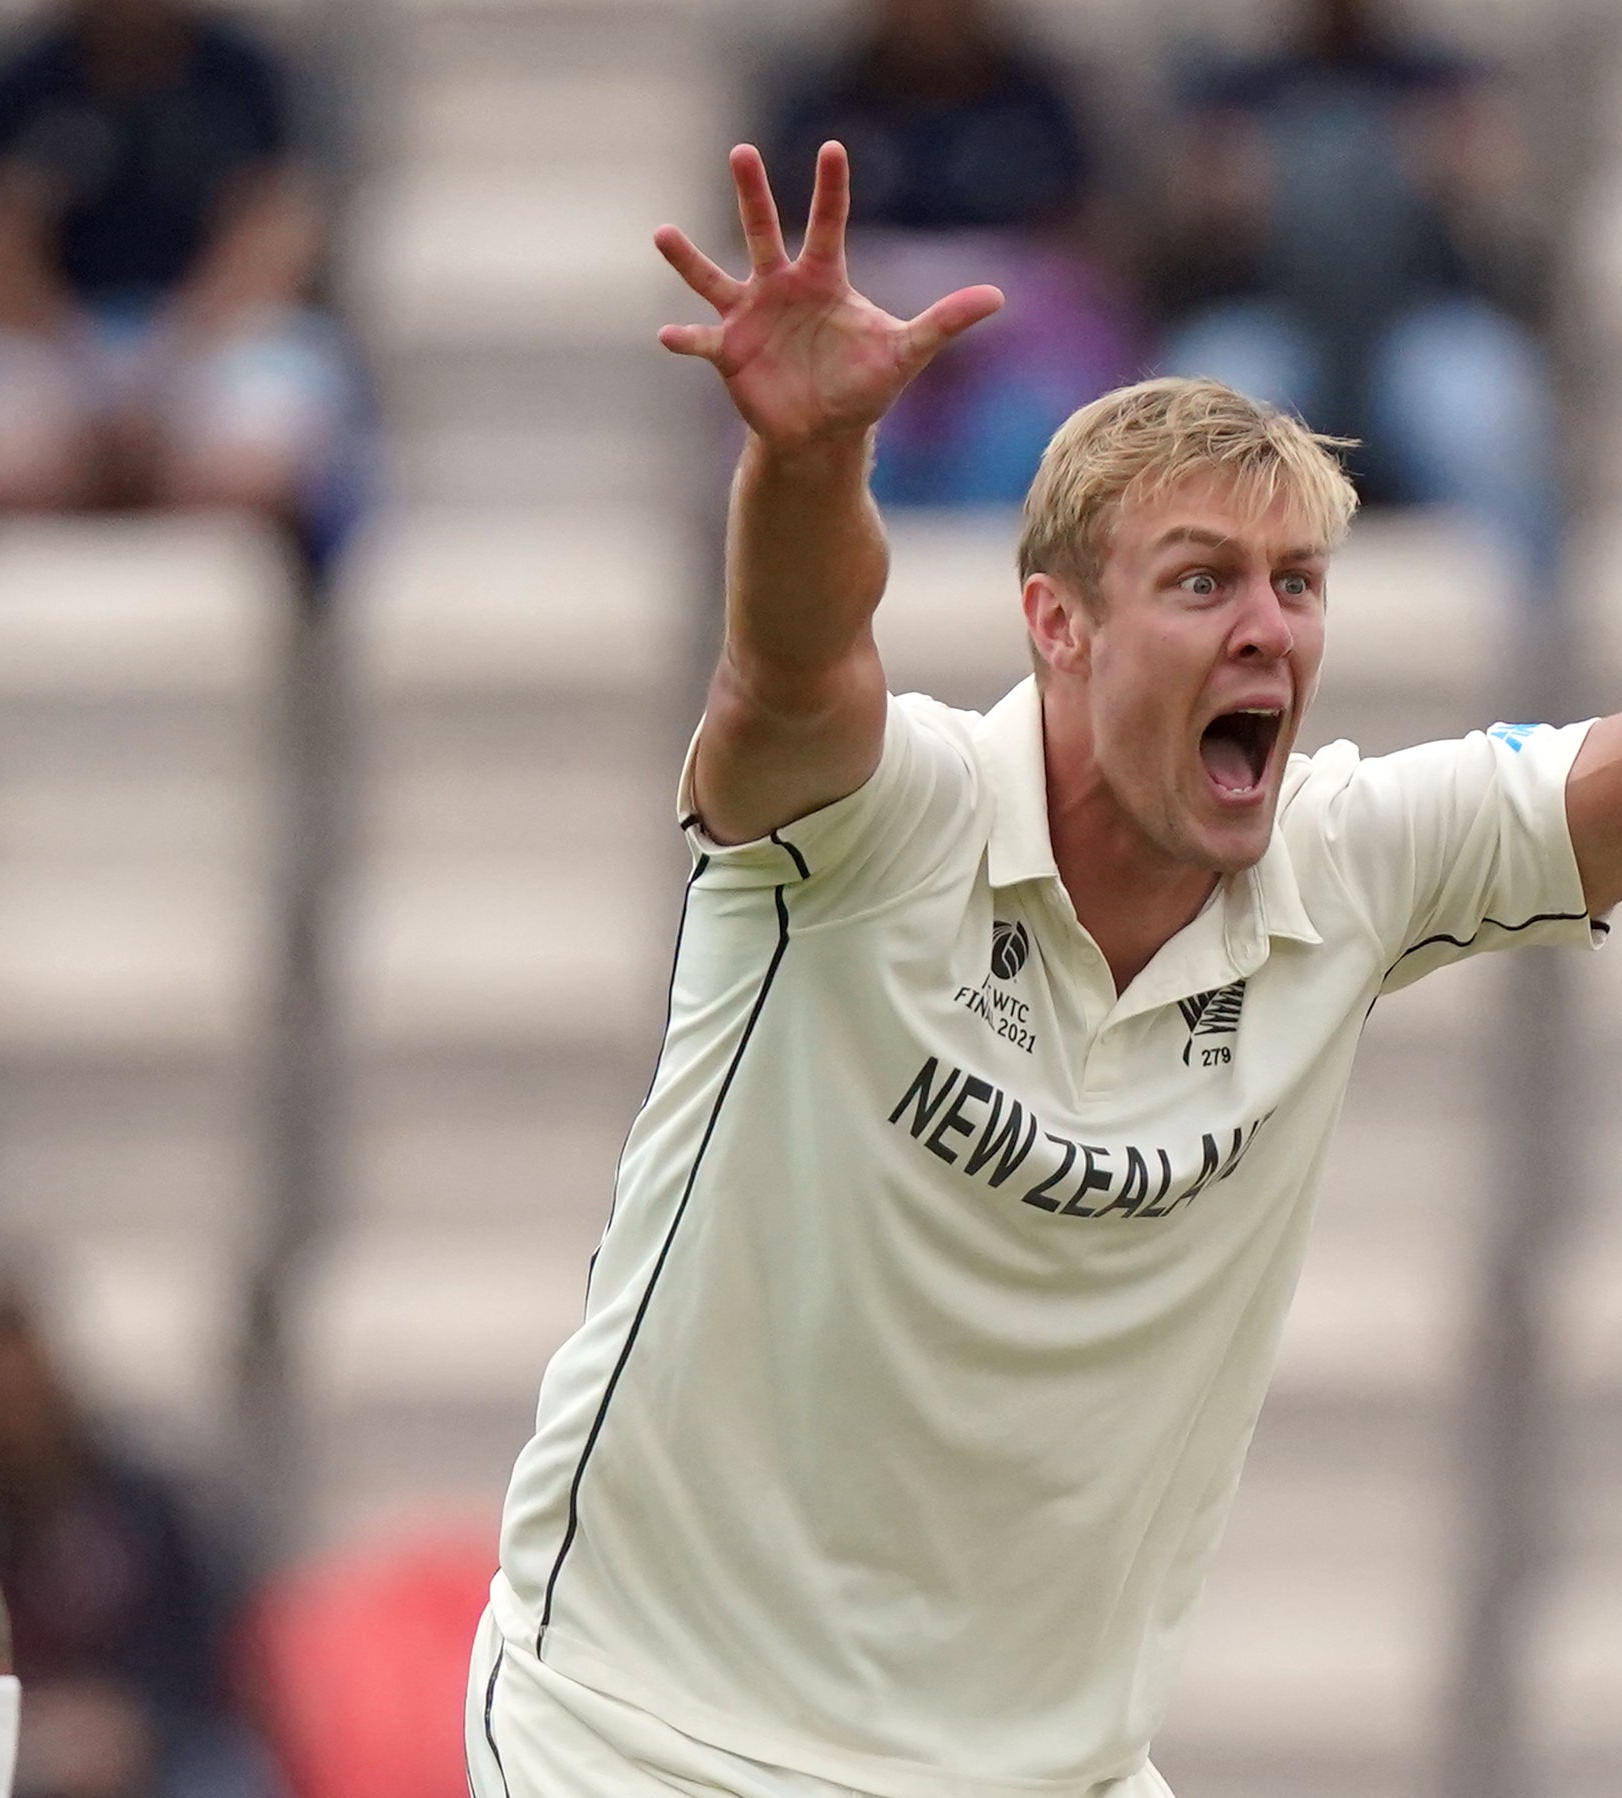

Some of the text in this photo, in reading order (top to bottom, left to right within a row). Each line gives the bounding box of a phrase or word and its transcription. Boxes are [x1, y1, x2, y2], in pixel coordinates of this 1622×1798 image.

[993, 987, 1030, 1024] WTC
[997, 1017, 1037, 1055] 2021
[1201, 1046, 1232, 1067] 279
[888, 1055, 1278, 1219] NEW ZEALAN
